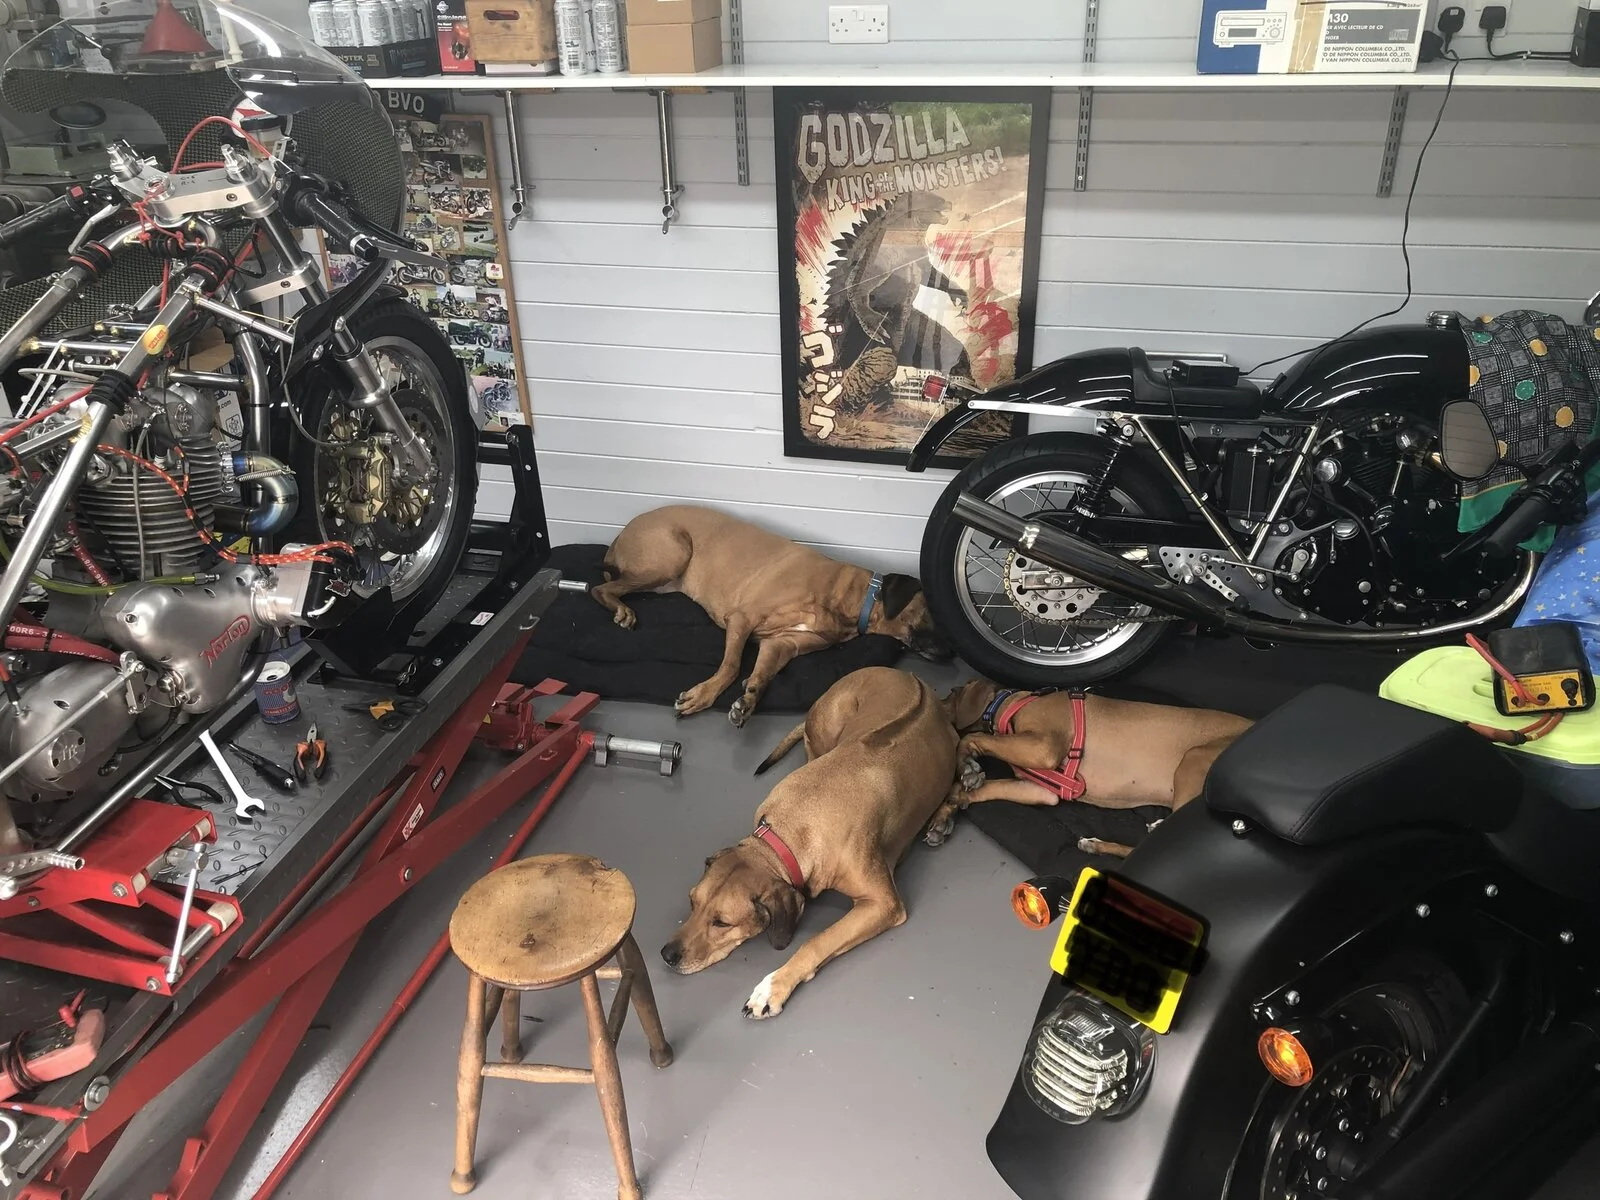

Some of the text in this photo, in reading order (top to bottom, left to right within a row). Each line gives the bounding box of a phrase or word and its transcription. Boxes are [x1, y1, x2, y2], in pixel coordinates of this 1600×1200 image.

[387, 90, 425, 114] BVO
[797, 107, 972, 184] GODZILLA
[826, 172, 877, 213] KING
[875, 181, 896, 195] THE
[893, 146, 1008, 195] MONSTERS!
[8, 625, 34, 636] 00R6
[199, 615, 250, 669] Norton
